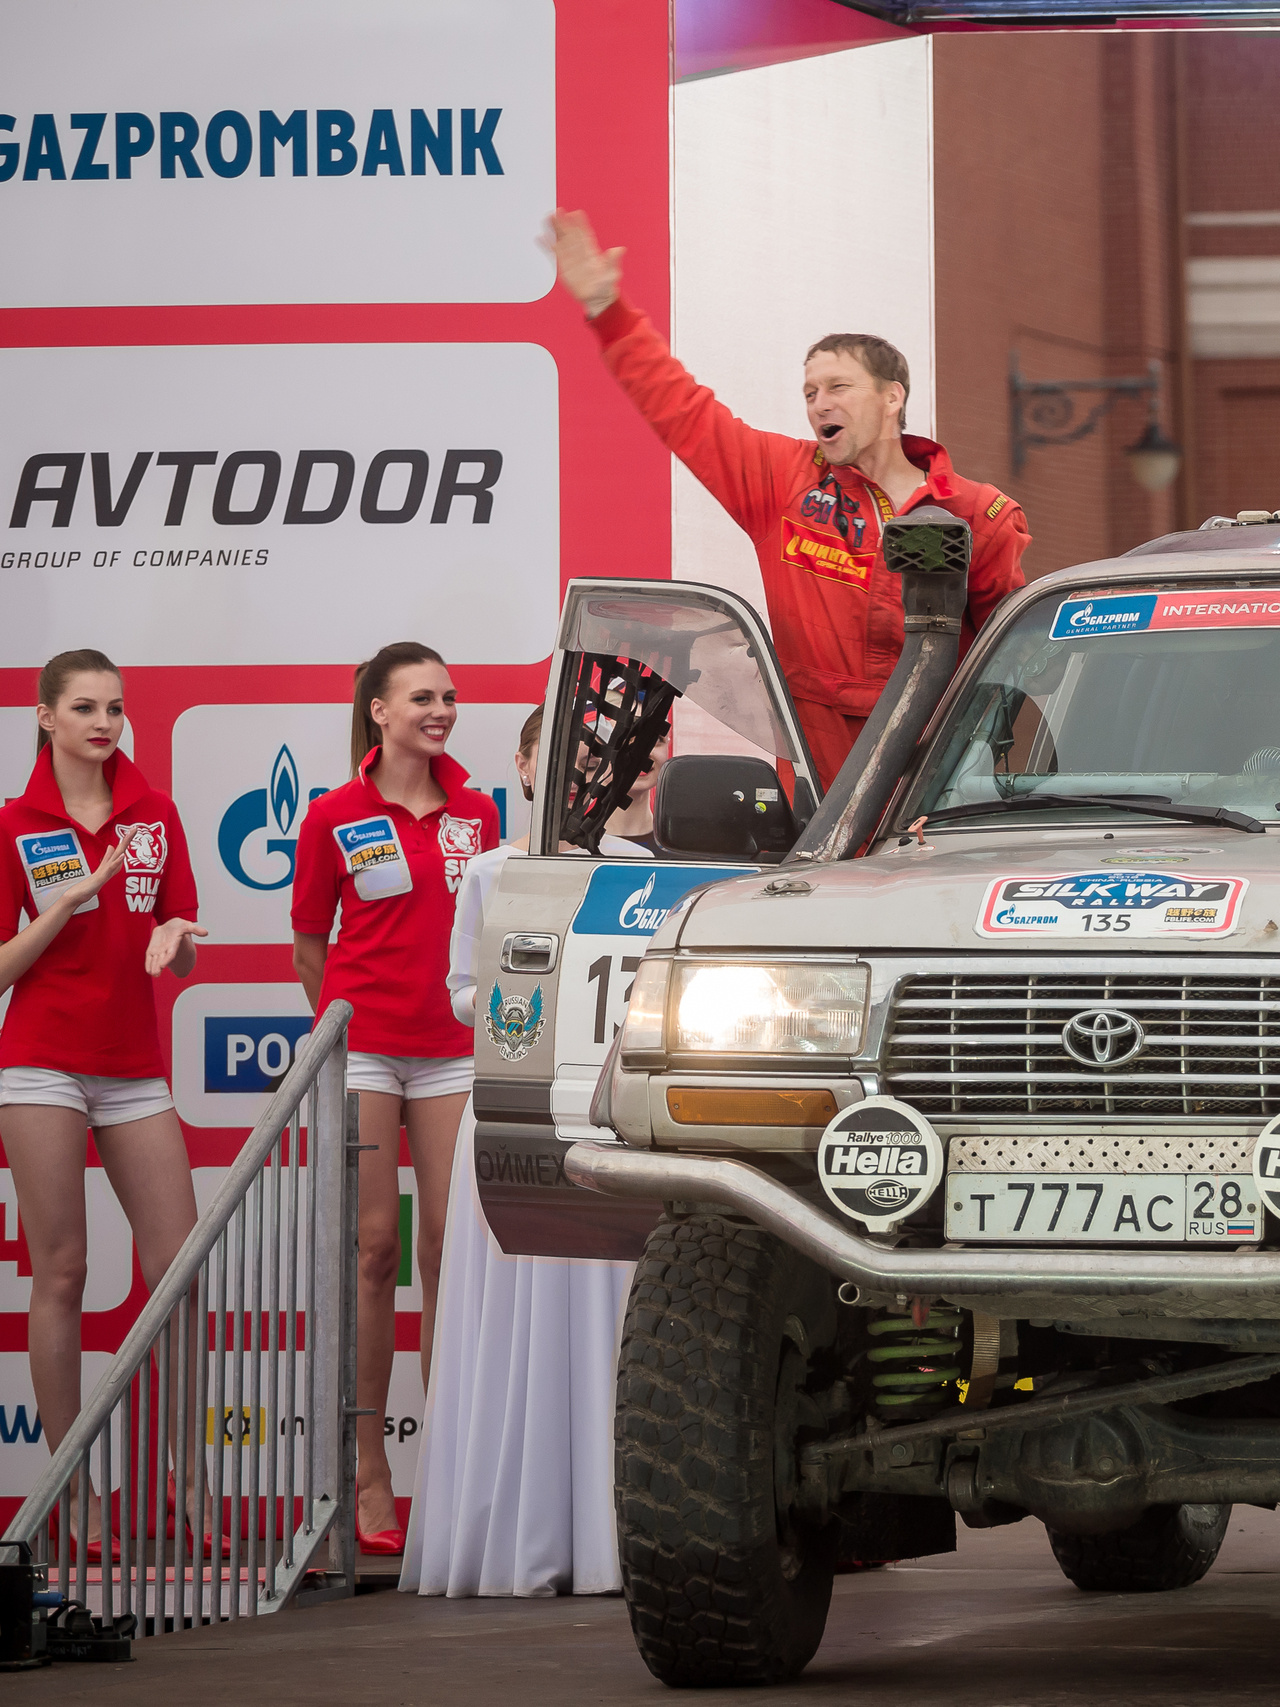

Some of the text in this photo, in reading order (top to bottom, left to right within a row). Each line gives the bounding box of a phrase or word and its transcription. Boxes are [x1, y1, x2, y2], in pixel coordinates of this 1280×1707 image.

[9, 449, 503, 528] AVTODOR
[1, 549, 269, 569] GROUP OF COMPANIES
[1089, 612, 1140, 625] GAZPROM
[1012, 883, 1220, 898] SILK WAY
[1071, 898, 1152, 906] RALLY
[1014, 915, 1058, 924] GAZPROM
[1081, 914, 1131, 932] 135
[1164, 916, 1216, 924] FBLIFE.COM
[504, 996, 530, 1009] RUSSIAN
[847, 1132, 923, 1145] Rallye 1000
[831, 1147, 922, 1174] Hella
[869, 1187, 908, 1199] HELLA
[1193, 1181, 1242, 1218] 28
[1189, 1222, 1225, 1235] RUS
